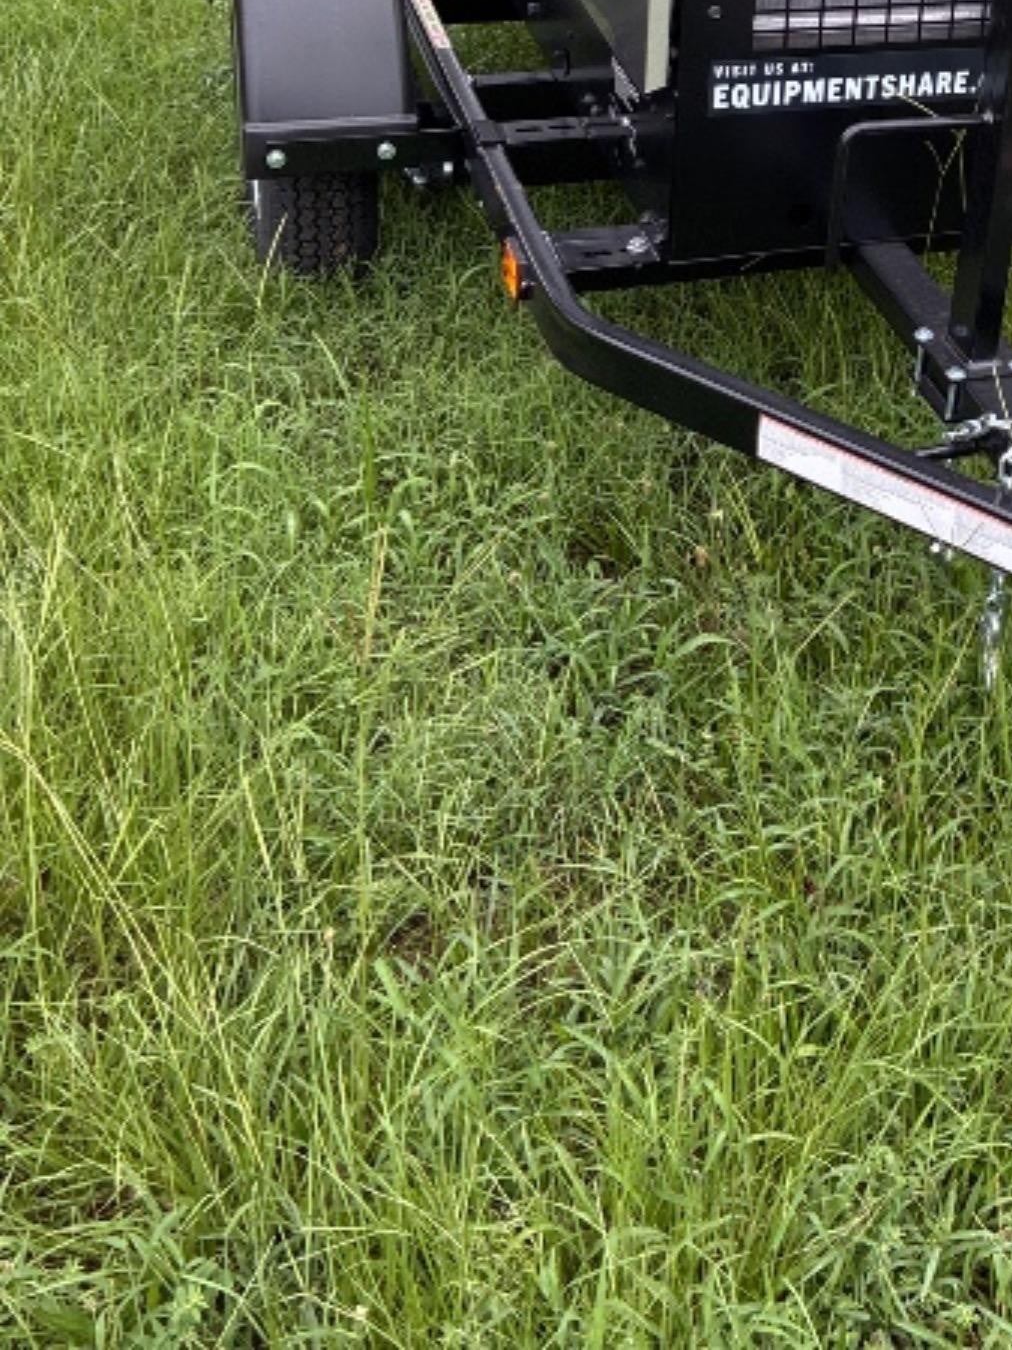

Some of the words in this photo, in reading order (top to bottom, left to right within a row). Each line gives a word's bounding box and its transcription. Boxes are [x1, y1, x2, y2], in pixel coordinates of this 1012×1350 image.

[712, 64, 757, 80] VISIT
[763, 62, 785, 77] US
[712, 70, 984, 110] EQUIPMENTSHARE.
